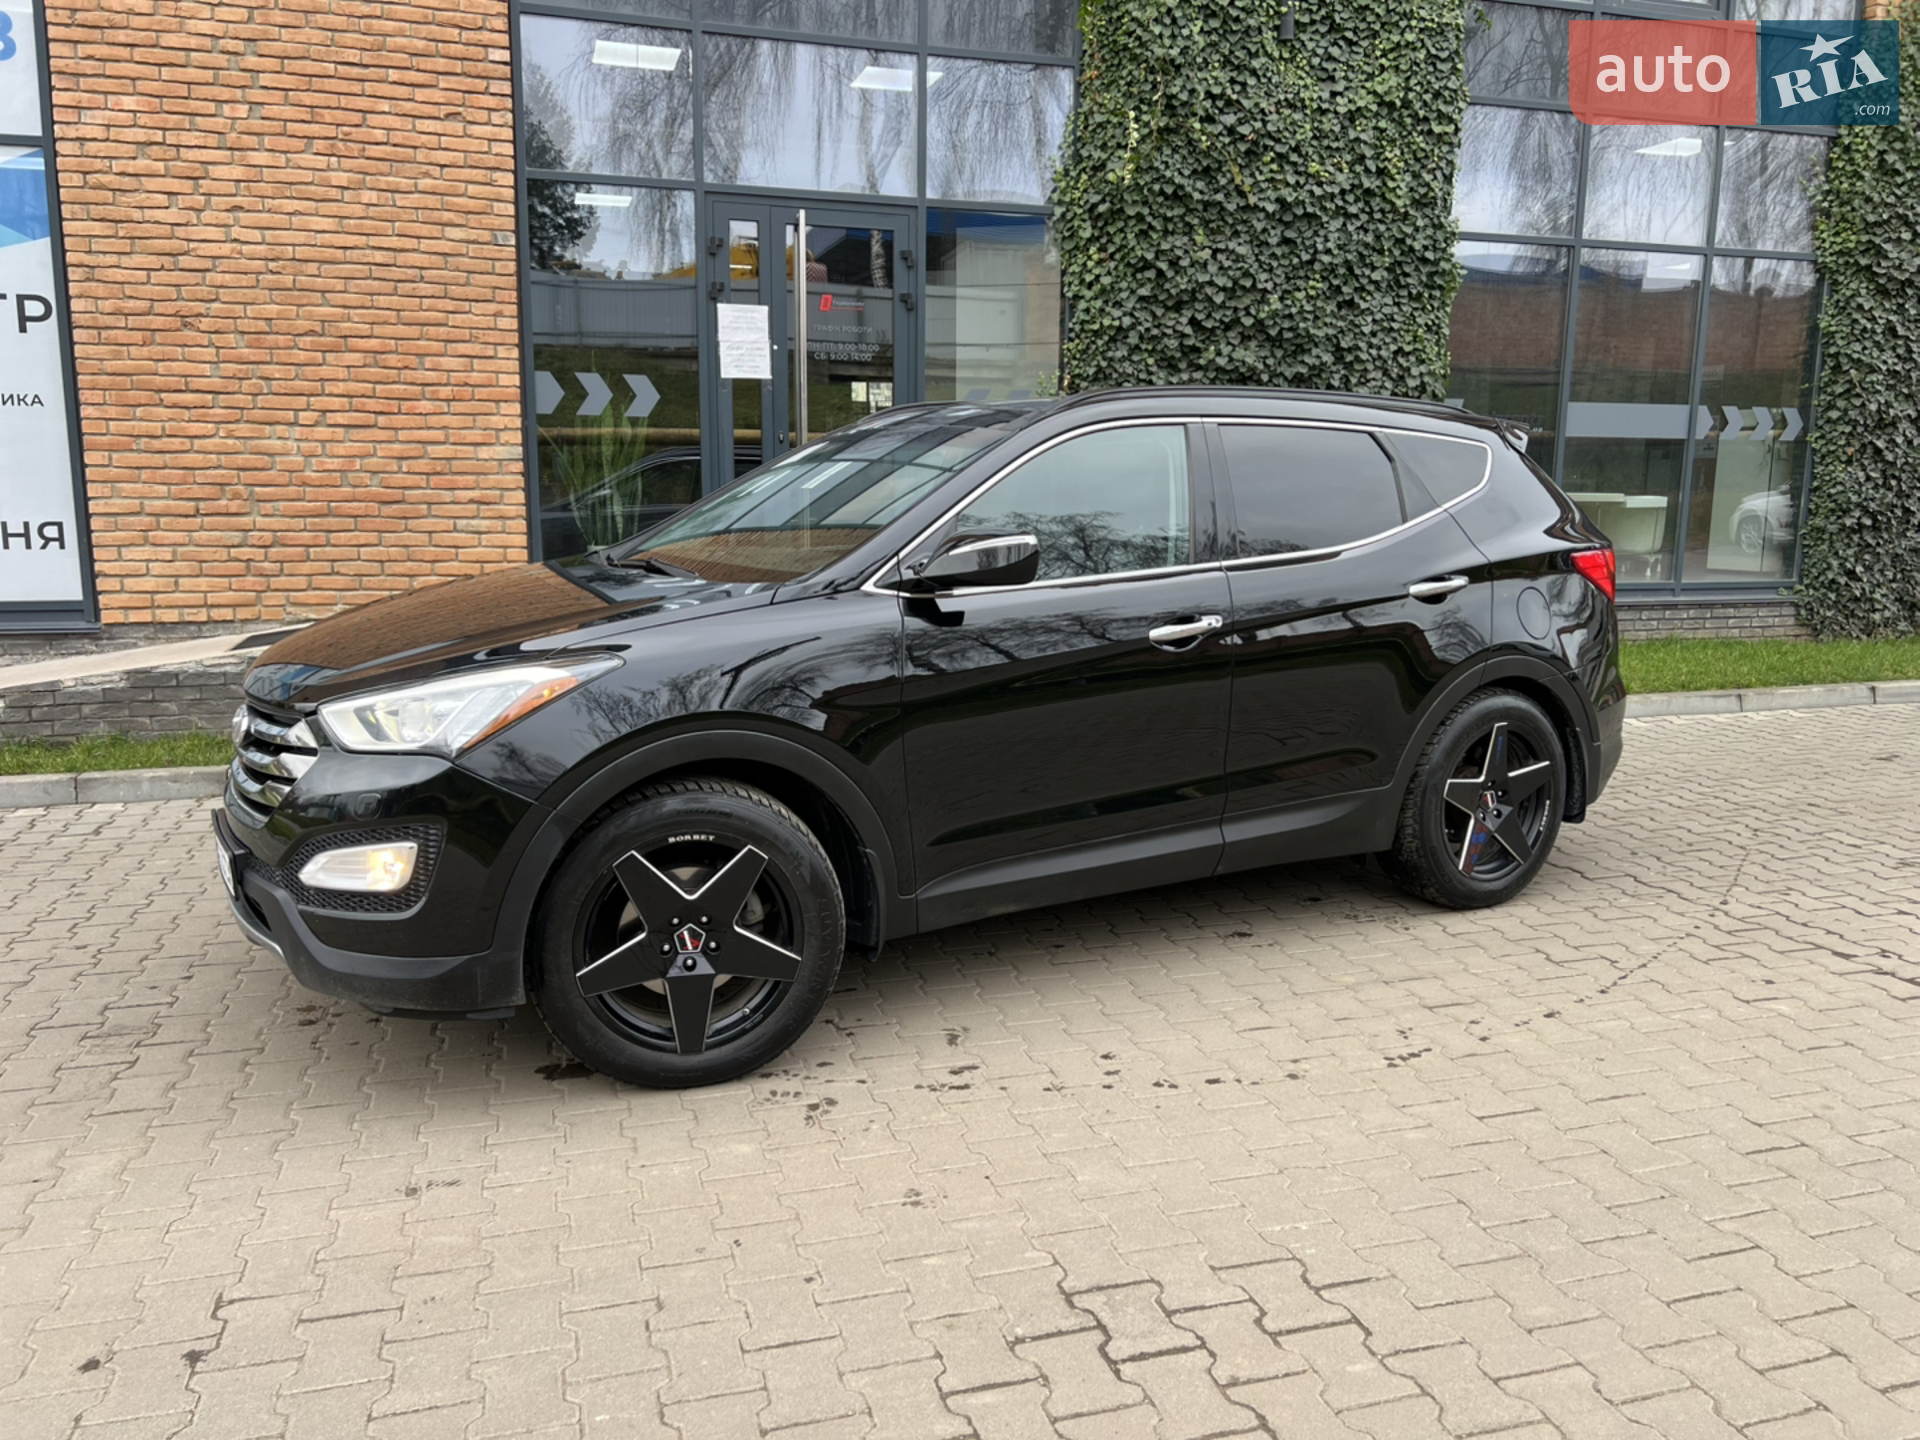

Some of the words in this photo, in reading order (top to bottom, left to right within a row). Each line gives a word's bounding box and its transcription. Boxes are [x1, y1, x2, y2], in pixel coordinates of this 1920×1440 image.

[813, 324, 841, 333] ГРАФК
[842, 324, 873, 334] РОБОТИ
[0, 521, 66, 550] НЯ
[668, 834, 716, 843] BORBET
